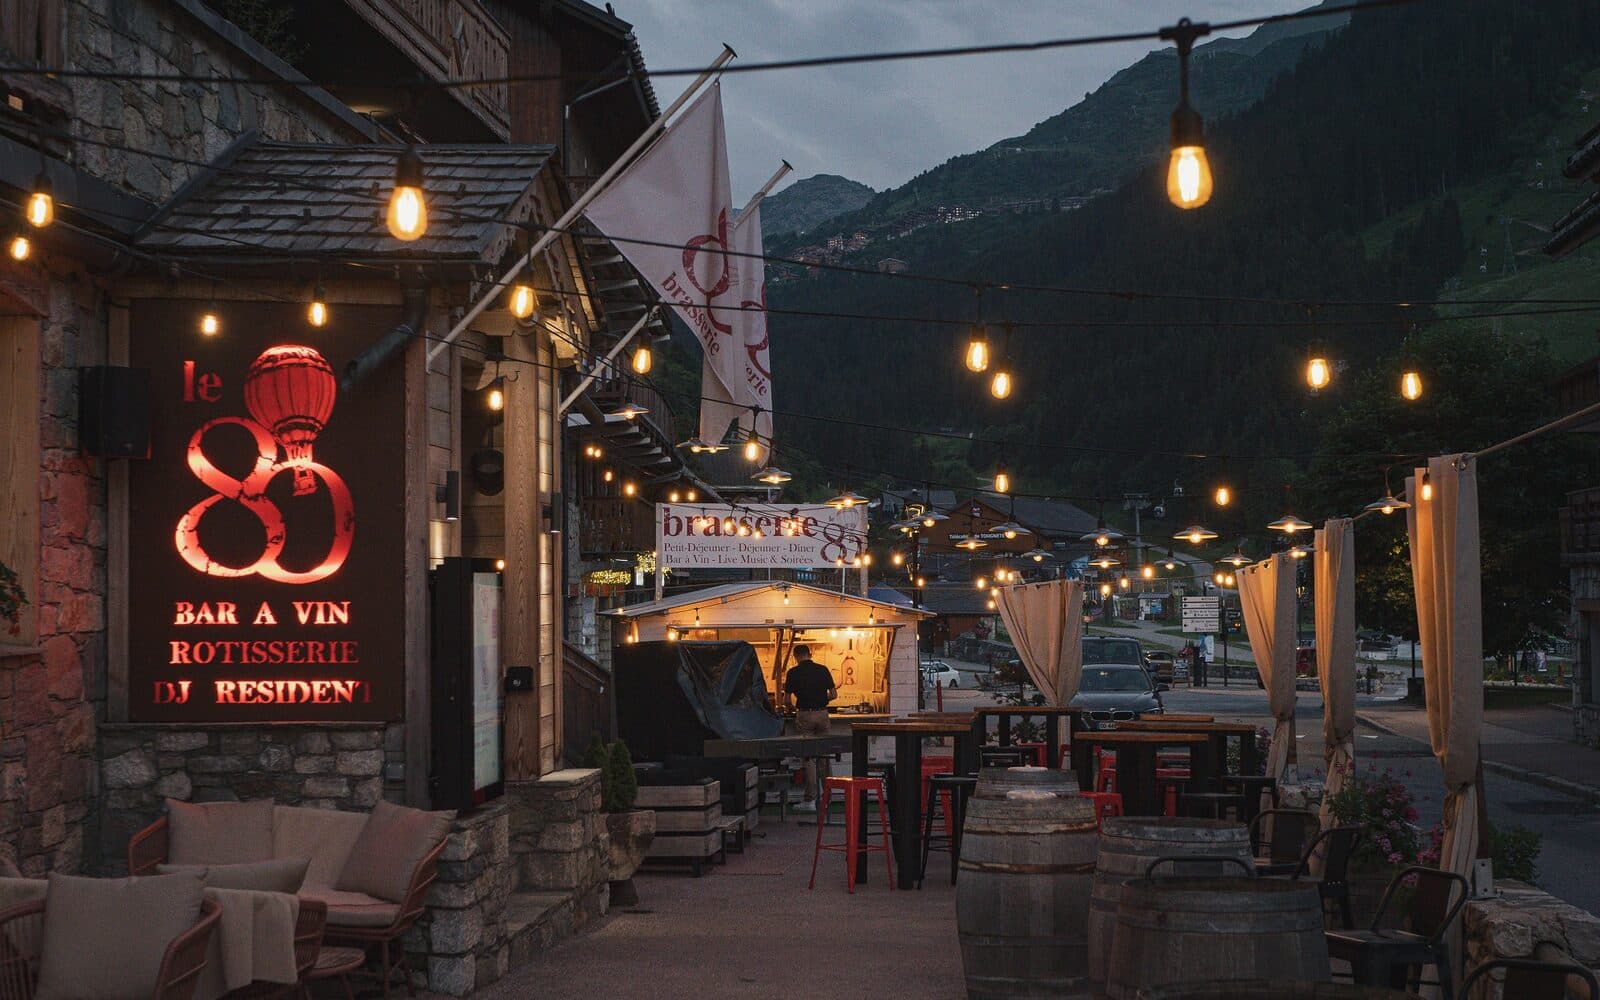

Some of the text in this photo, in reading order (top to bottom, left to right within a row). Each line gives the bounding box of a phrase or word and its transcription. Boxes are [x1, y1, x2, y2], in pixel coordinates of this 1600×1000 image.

[661, 271, 720, 356] brasserie
[183, 360, 222, 401] le
[174, 415, 354, 584] 80
[663, 507, 818, 538] brasserie
[664, 542, 730, 553] Petit-Déjeuner
[739, 542, 781, 553] Déjeuner
[666, 554, 681, 564] Bar
[693, 554, 710, 564] Vin
[719, 554, 738, 564] Live
[741, 554, 768, 564] Music
[770, 554, 777, 564] &
[781, 554, 814, 564] Soirées
[174, 601, 351, 625] BAR A VIN
[169, 640, 360, 665] ROTISSERIE
[154, 680, 371, 704] DJ RESIDENT
